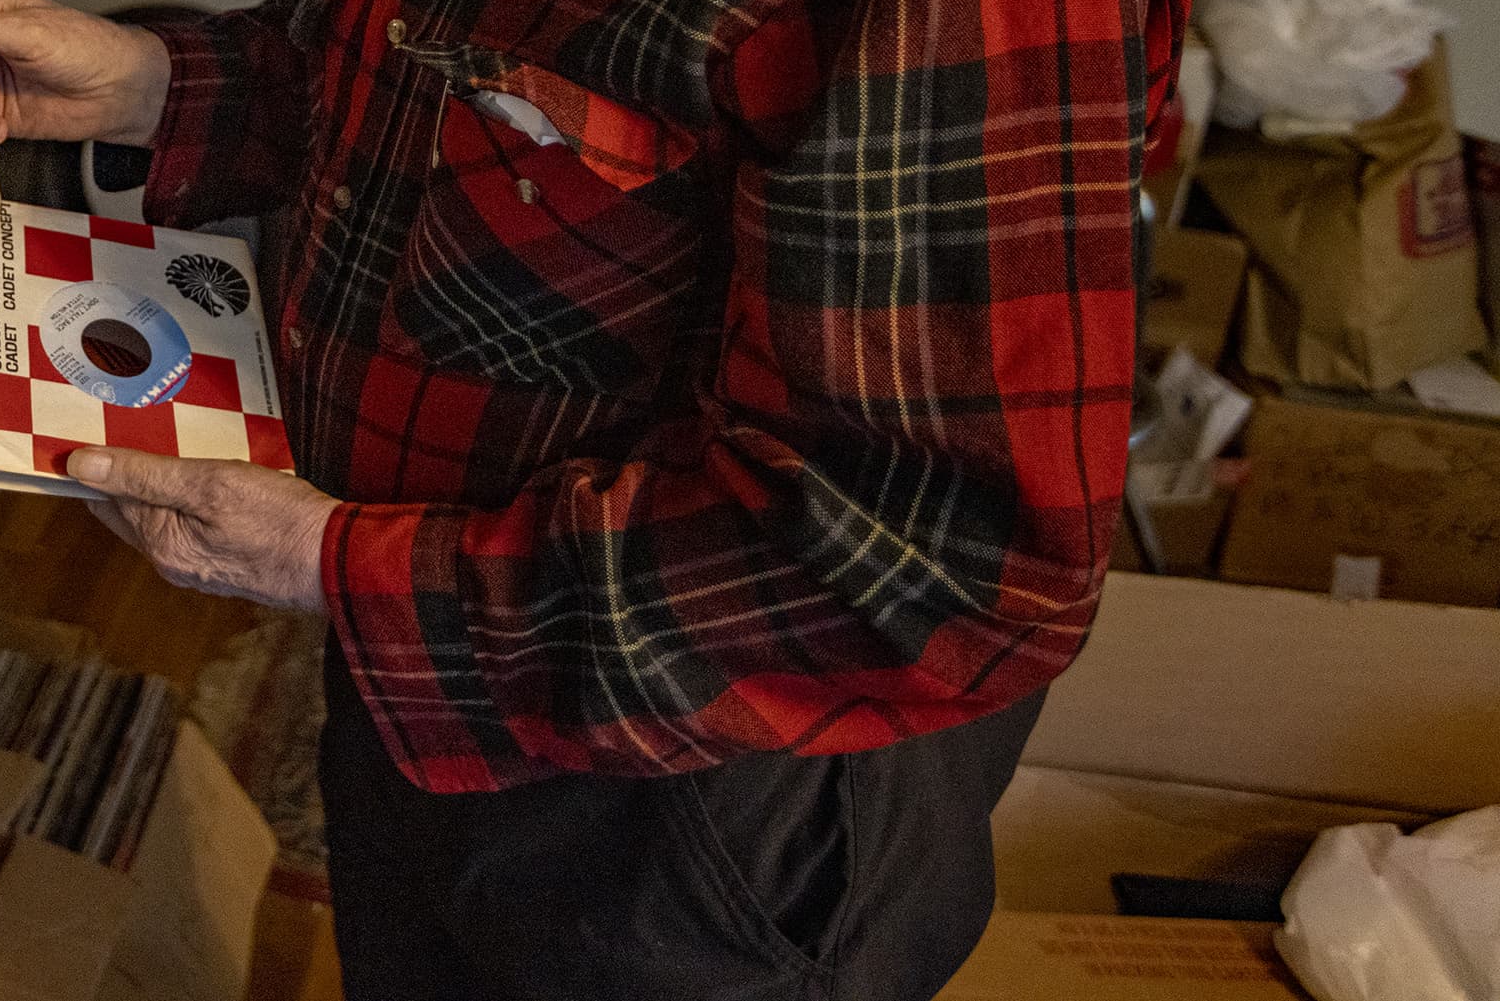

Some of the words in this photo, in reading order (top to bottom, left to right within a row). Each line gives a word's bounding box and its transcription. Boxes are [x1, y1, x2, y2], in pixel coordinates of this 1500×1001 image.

[0, 203, 14, 260] CONCEPT
[2, 263, 16, 311] CADET
[4, 323, 20, 372] CADET
